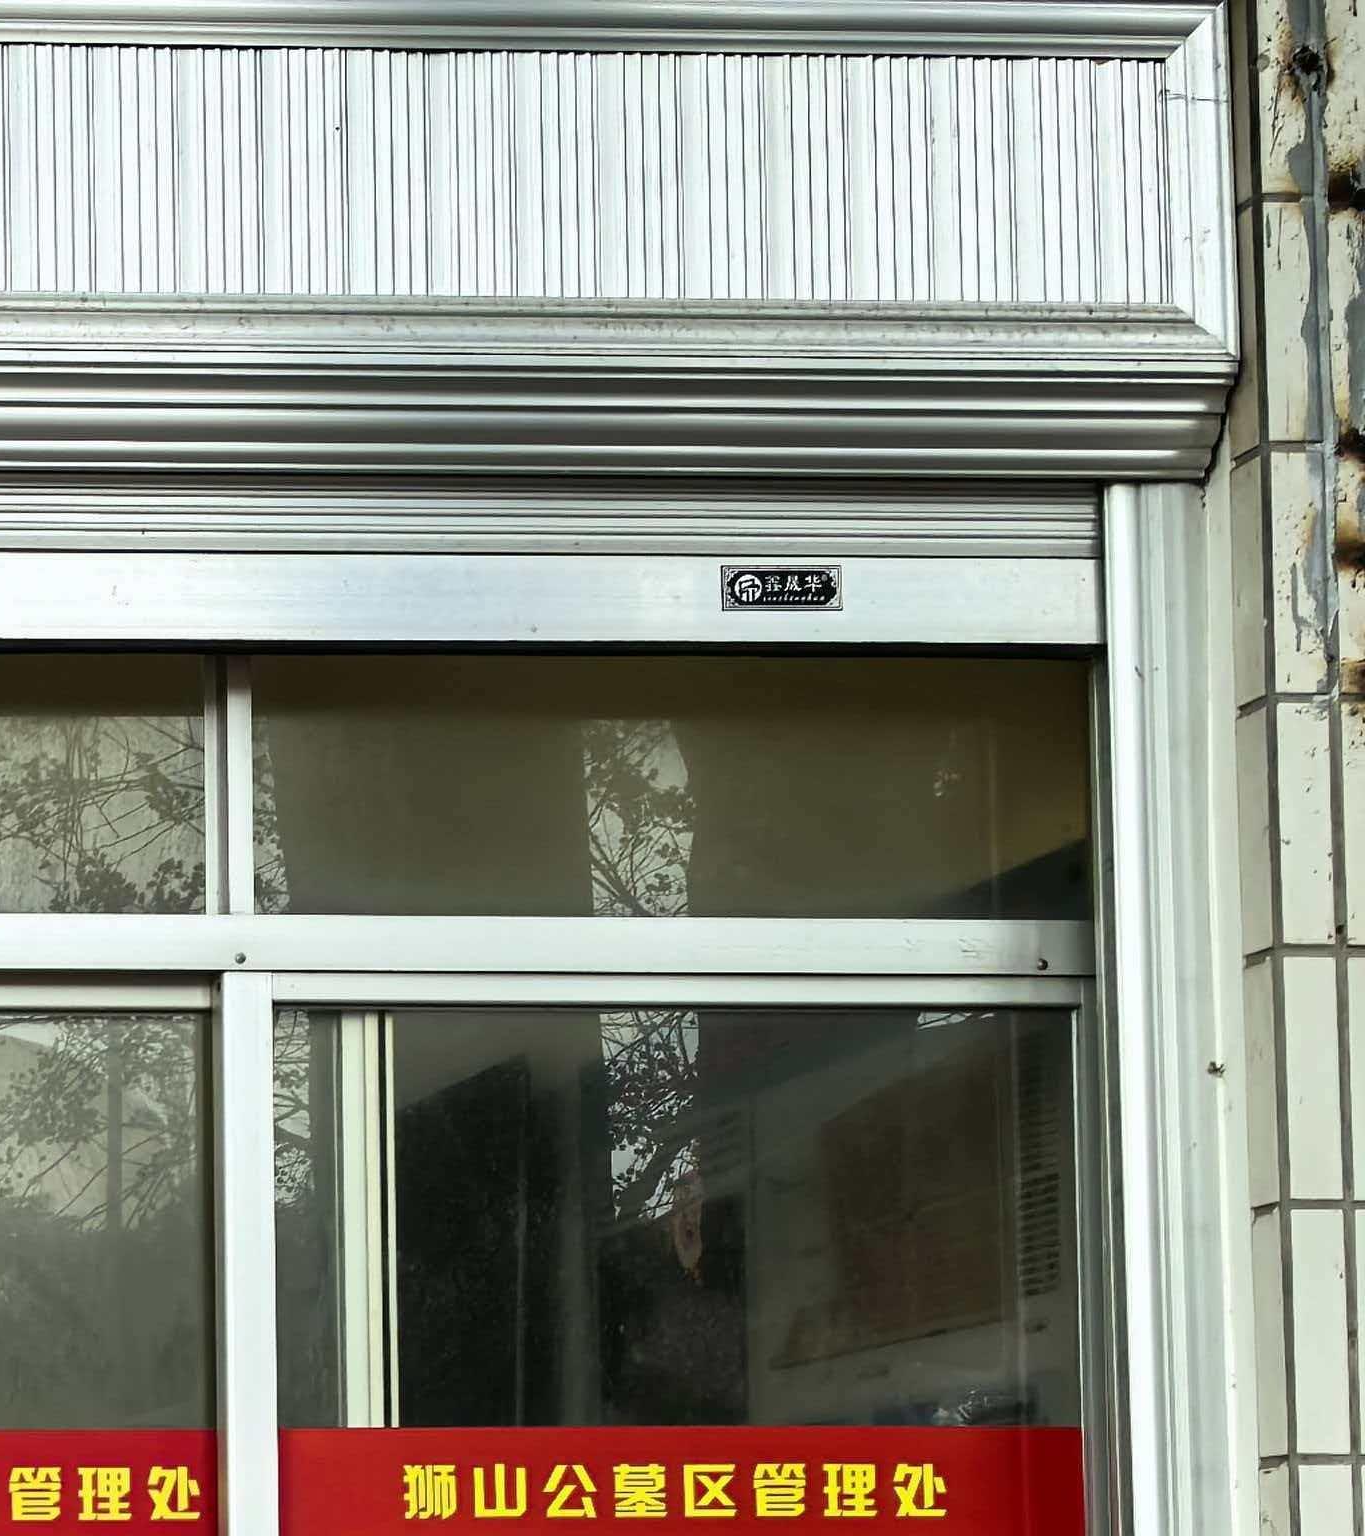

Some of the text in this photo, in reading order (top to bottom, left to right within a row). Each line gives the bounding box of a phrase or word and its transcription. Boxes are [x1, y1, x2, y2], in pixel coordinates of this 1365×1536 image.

[402, 1462, 948, 1519] 狮山公墓区管理处
